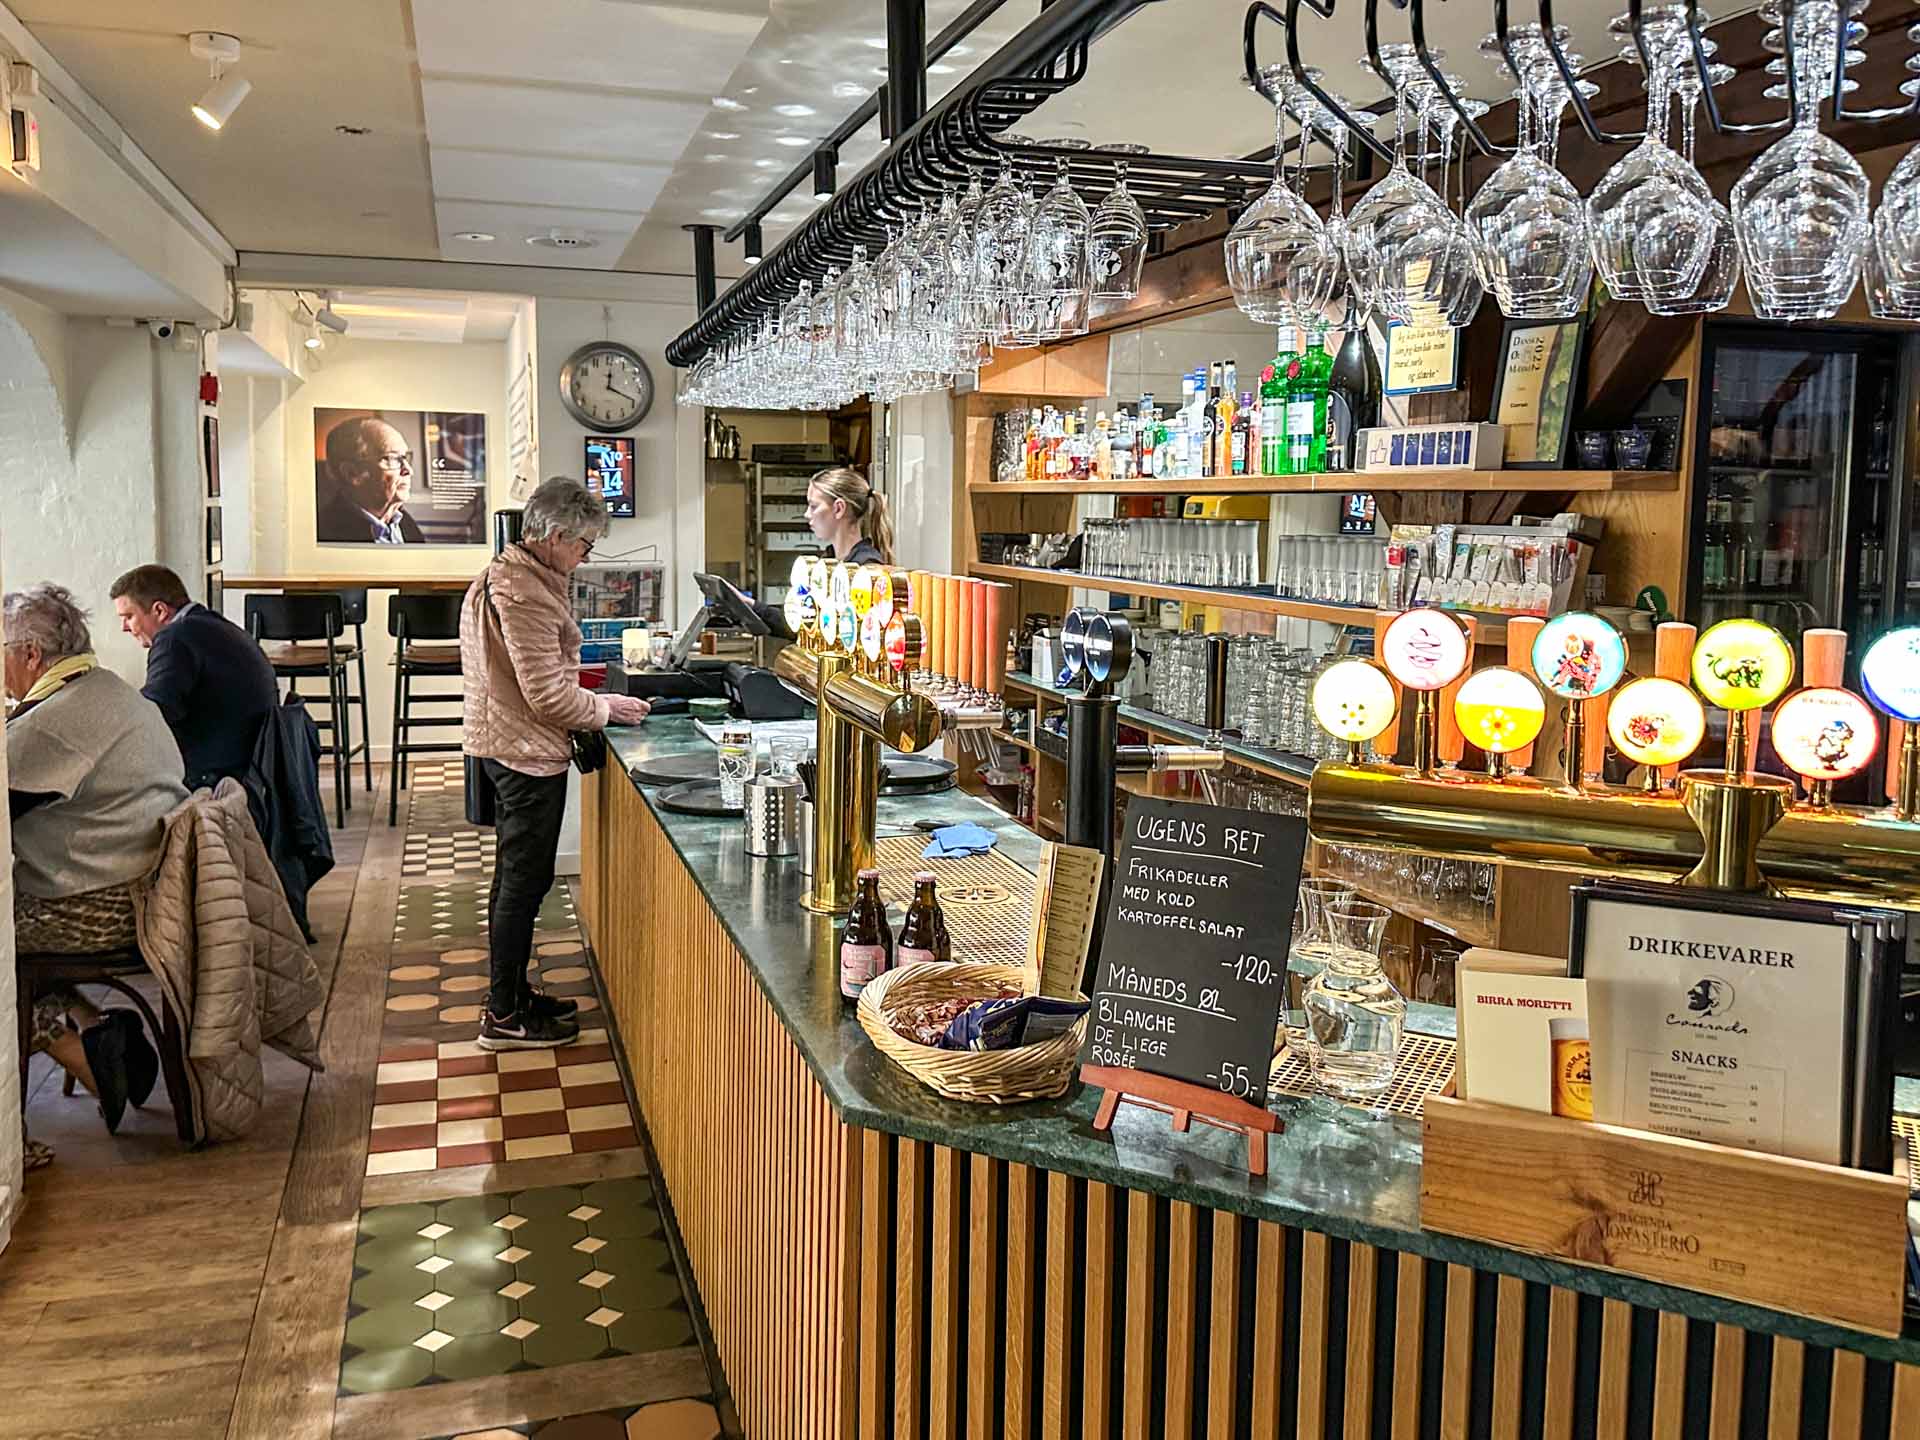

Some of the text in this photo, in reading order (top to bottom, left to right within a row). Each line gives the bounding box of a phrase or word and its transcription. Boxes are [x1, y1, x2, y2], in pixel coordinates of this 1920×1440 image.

[601, 471, 624, 491] 14
[1136, 815, 1265, 855] UGENS RET
[1128, 857, 1229, 889] FRIKADELLER
[1122, 885, 1195, 907] MED KOLD
[1117, 906, 1245, 939] KARTOFFELSALAT
[1628, 935, 1795, 968] DRIKKEVARER
[1107, 962, 1226, 1012] MÅNEDS ØL
[1476, 994, 1572, 1011] BIRRA MORETTI
[1098, 998, 1176, 1034] BLANCHE
[1091, 1045, 1137, 1069] ROSÉE
[1094, 1025, 1168, 1057] DE LIEGE
[1671, 1050, 1738, 1070] SNACKS
